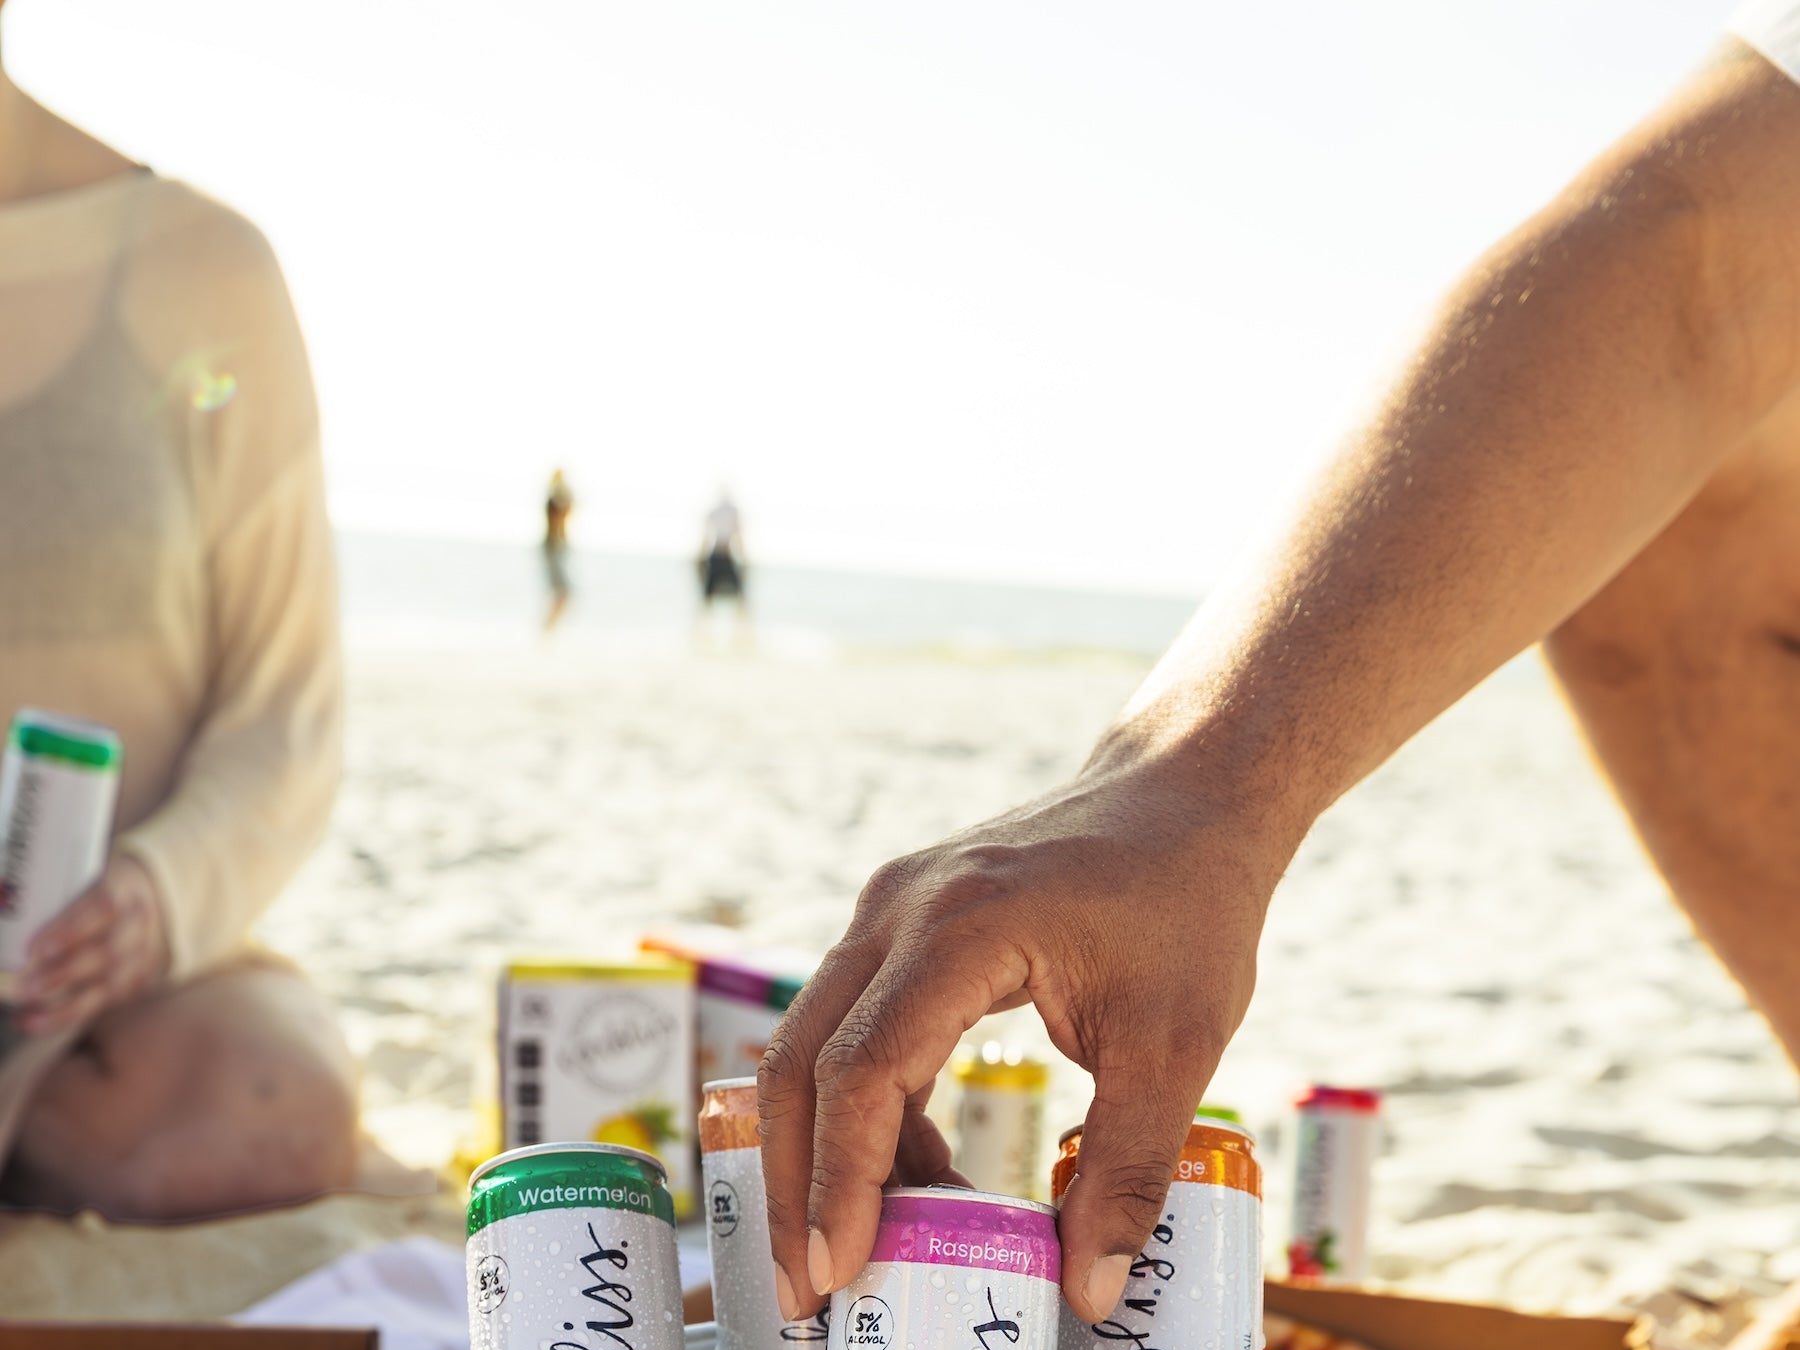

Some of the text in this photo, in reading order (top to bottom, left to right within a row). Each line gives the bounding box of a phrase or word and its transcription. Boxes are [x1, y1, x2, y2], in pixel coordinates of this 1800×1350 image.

[518, 1186, 650, 1208] Watermelon
[929, 1237, 1032, 1271] Raspberry
[855, 1312, 882, 1333] 5%
